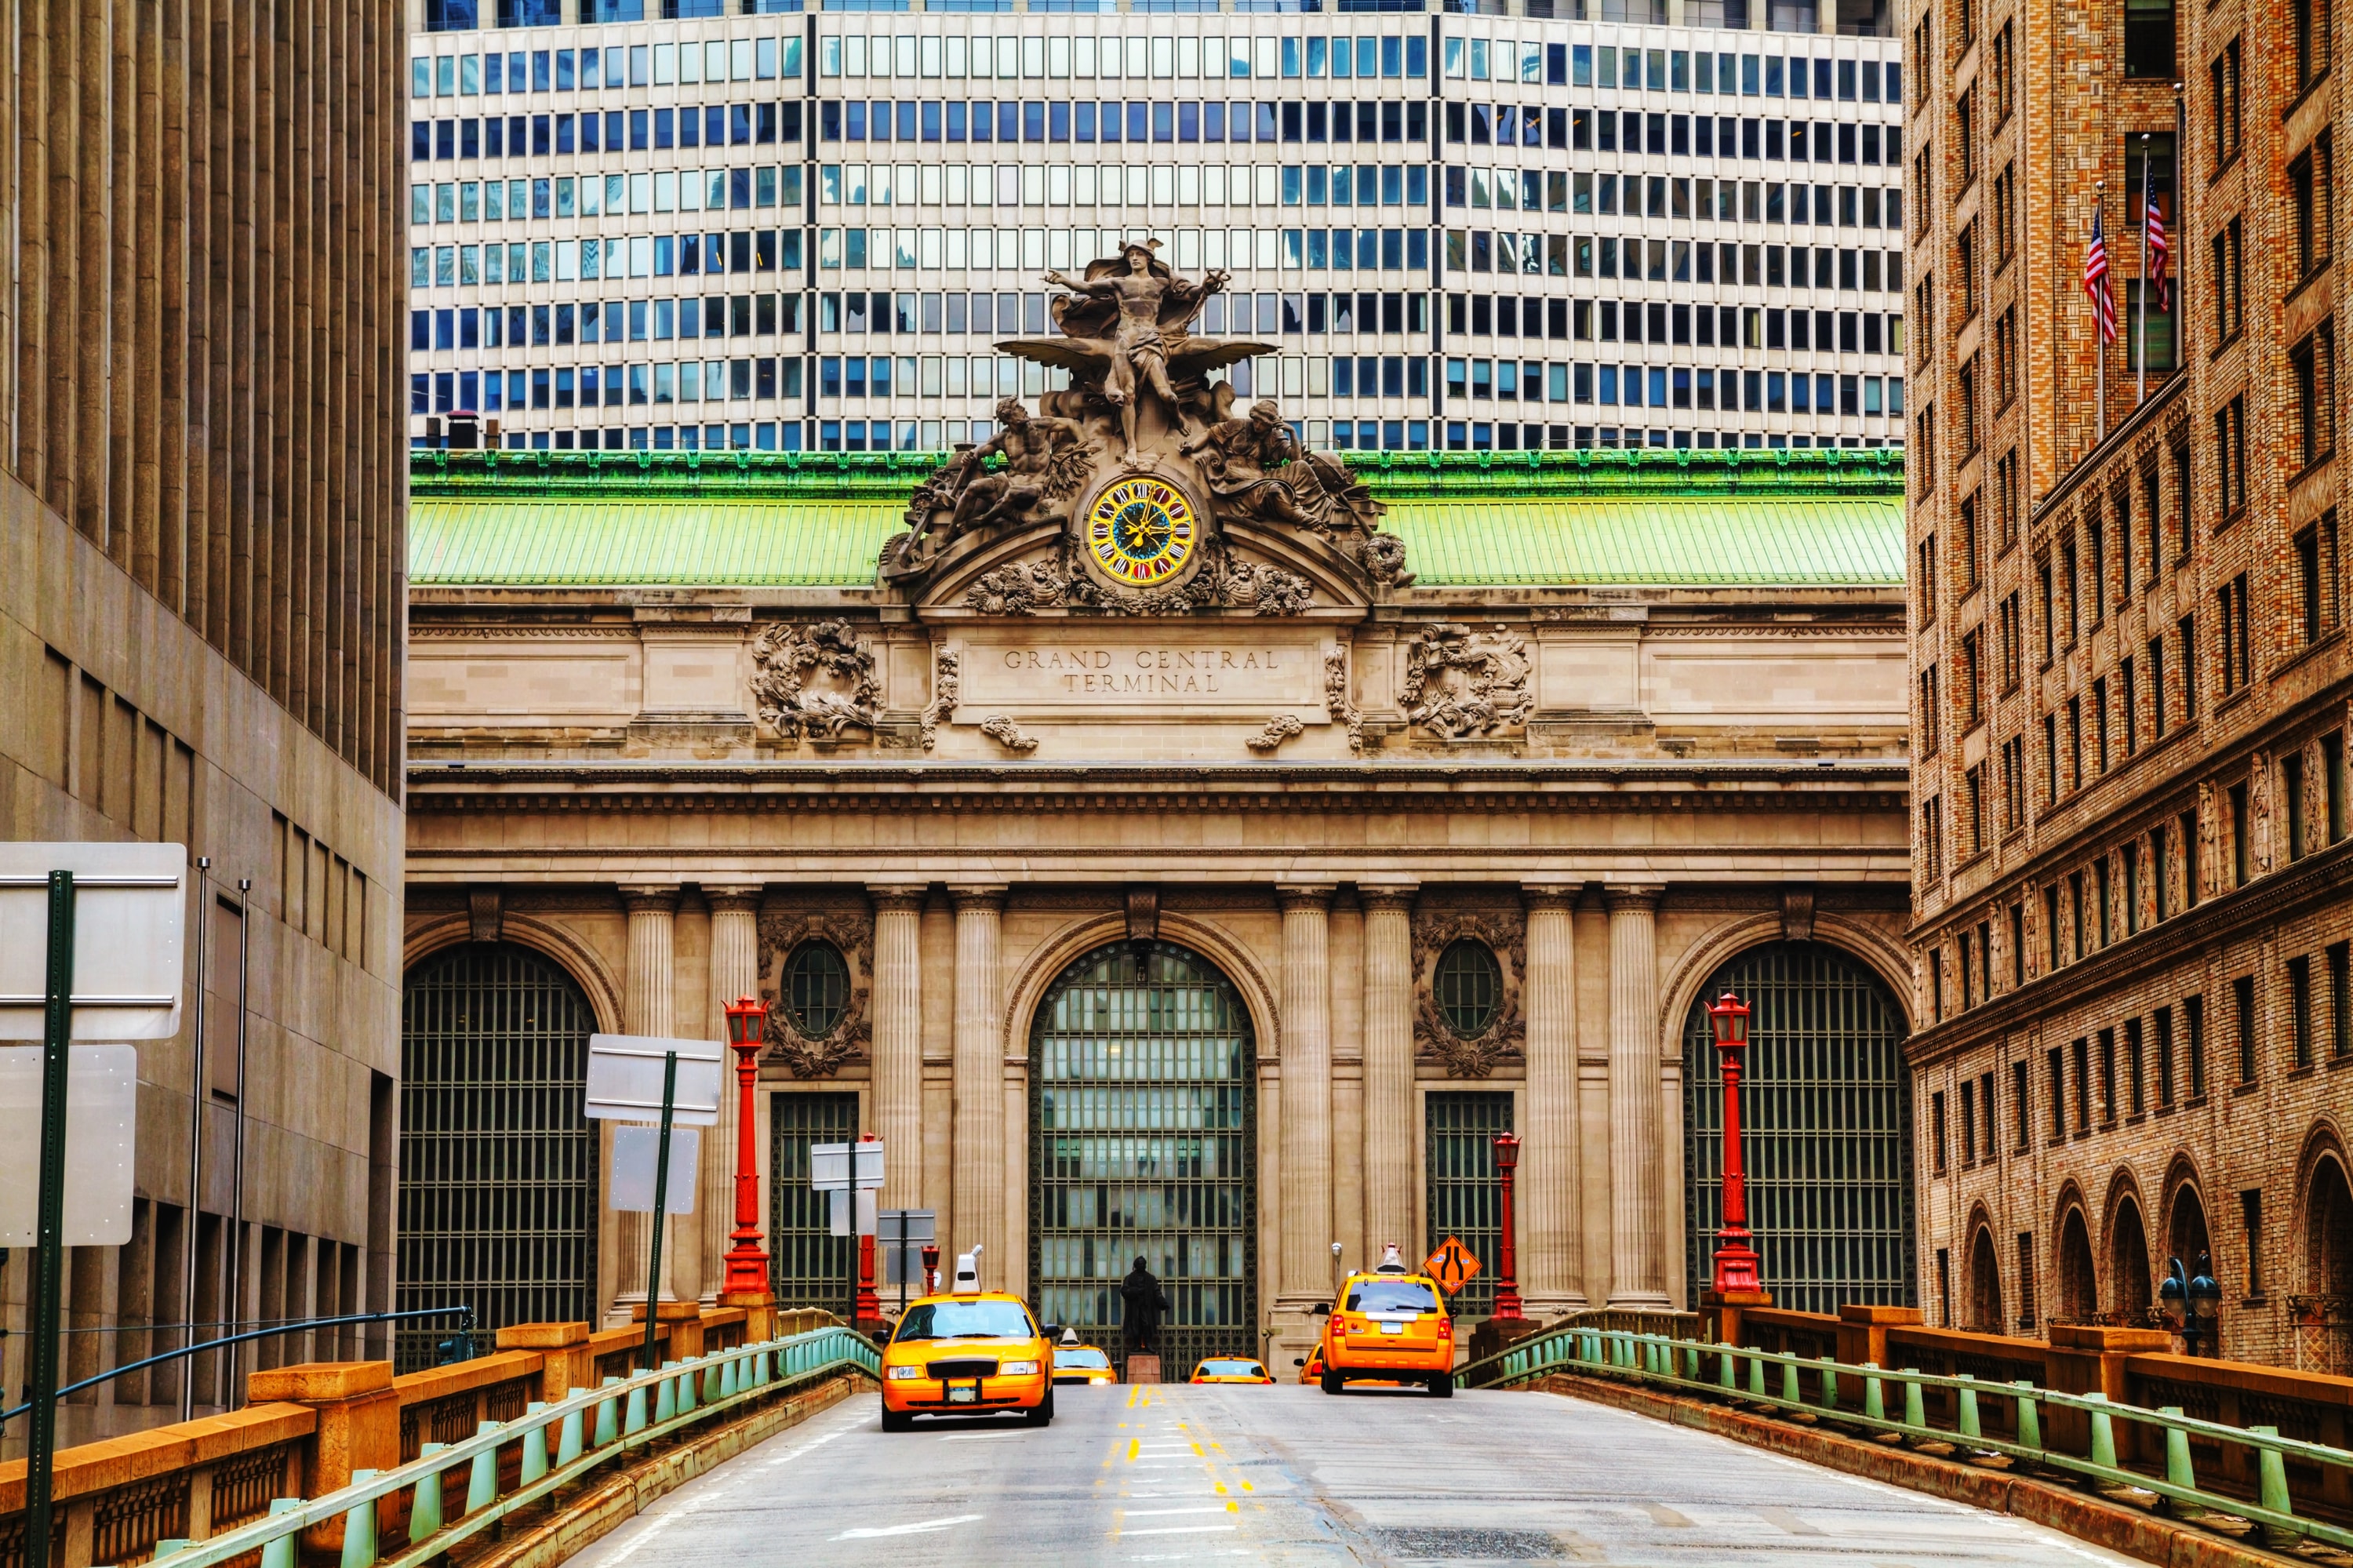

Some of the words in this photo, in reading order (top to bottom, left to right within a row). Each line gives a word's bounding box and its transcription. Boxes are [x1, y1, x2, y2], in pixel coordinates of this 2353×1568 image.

[1004, 650, 1111, 669] GRAND
[1136, 650, 1279, 669] CENTRAL
[1064, 674, 1220, 693] TERMINAL
